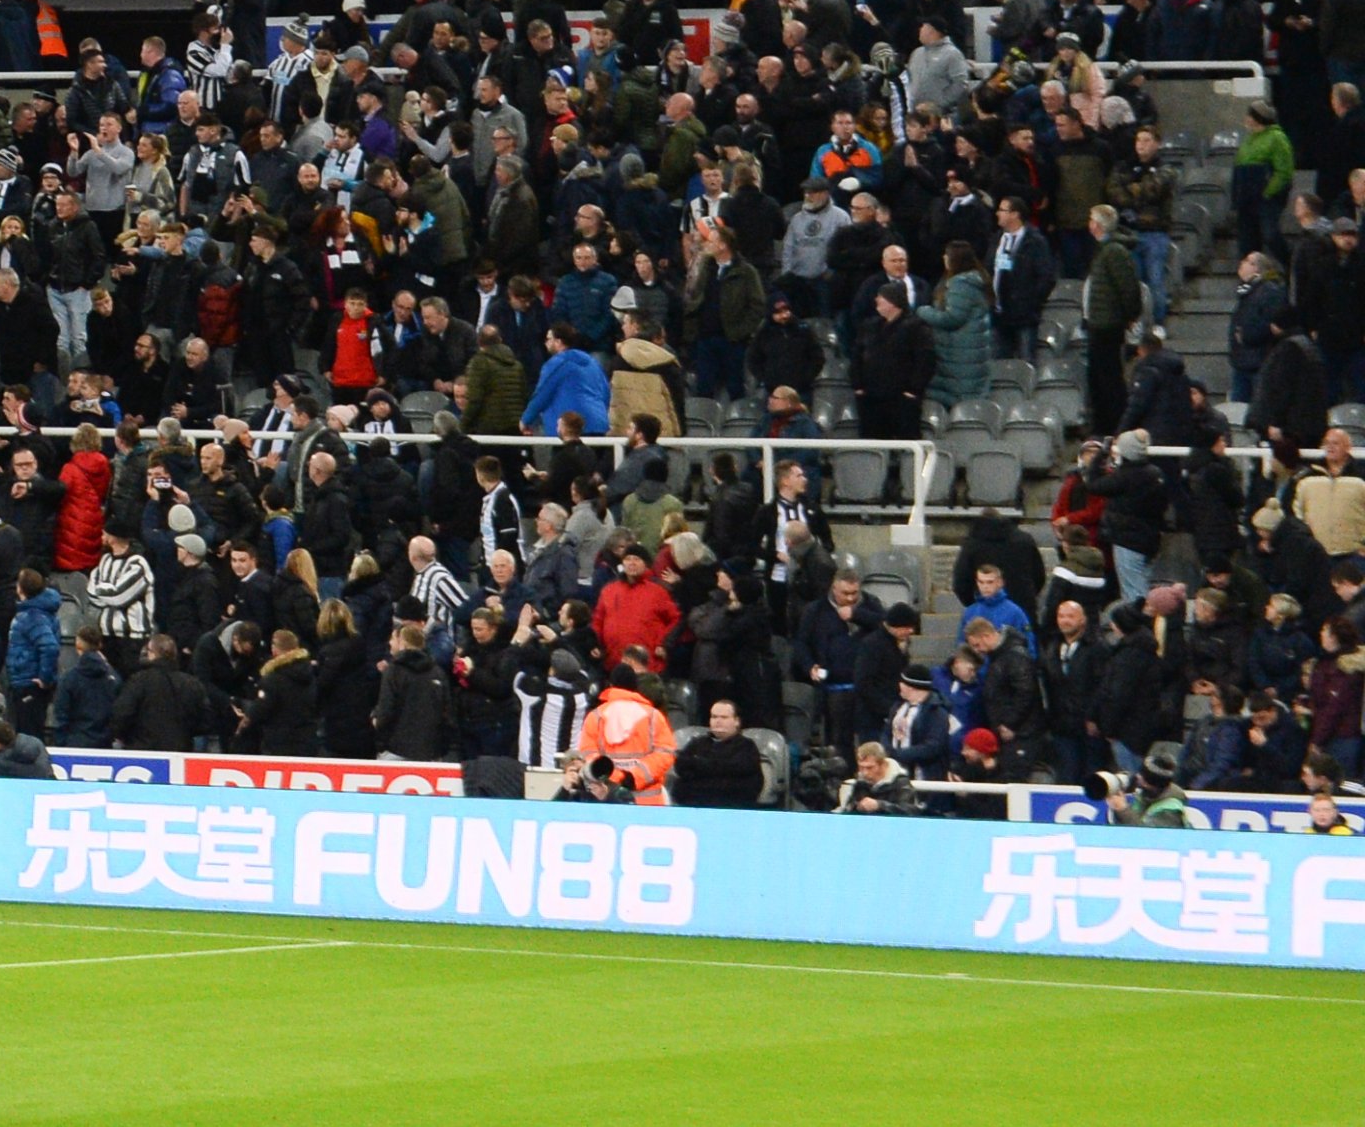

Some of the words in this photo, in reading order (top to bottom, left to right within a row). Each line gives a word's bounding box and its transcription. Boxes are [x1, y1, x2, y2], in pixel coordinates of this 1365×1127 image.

[19, 789, 276, 903] 乐天堂
[293, 810, 697, 926] FUN88
[973, 832, 1269, 955] 乐天堂
